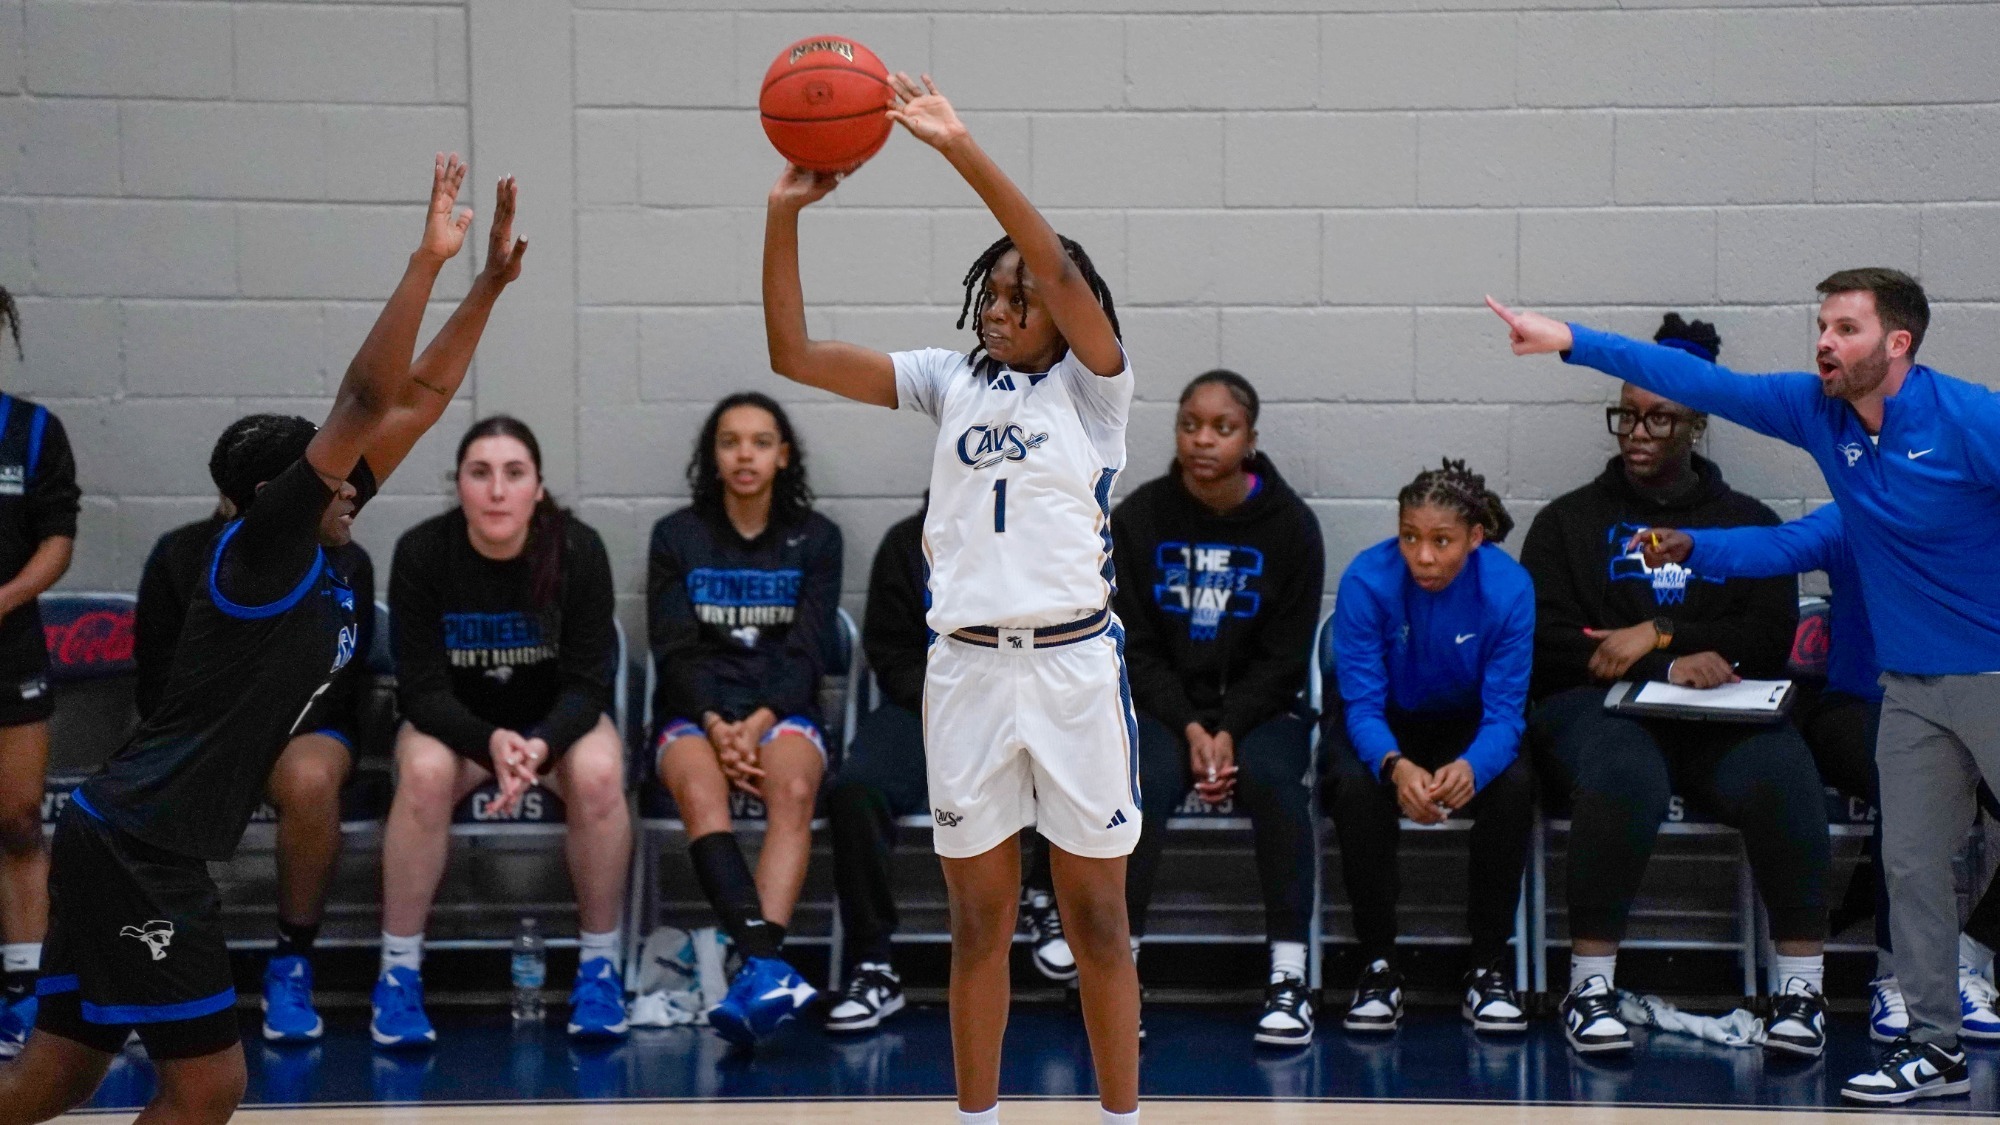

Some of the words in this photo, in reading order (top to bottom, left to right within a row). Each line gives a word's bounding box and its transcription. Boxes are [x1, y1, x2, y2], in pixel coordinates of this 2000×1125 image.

[955, 421, 1027, 467] CAVS
[992, 478, 1008, 533] 1
[1181, 547, 1231, 571] THE
[934, 807, 957, 827] CAVS
